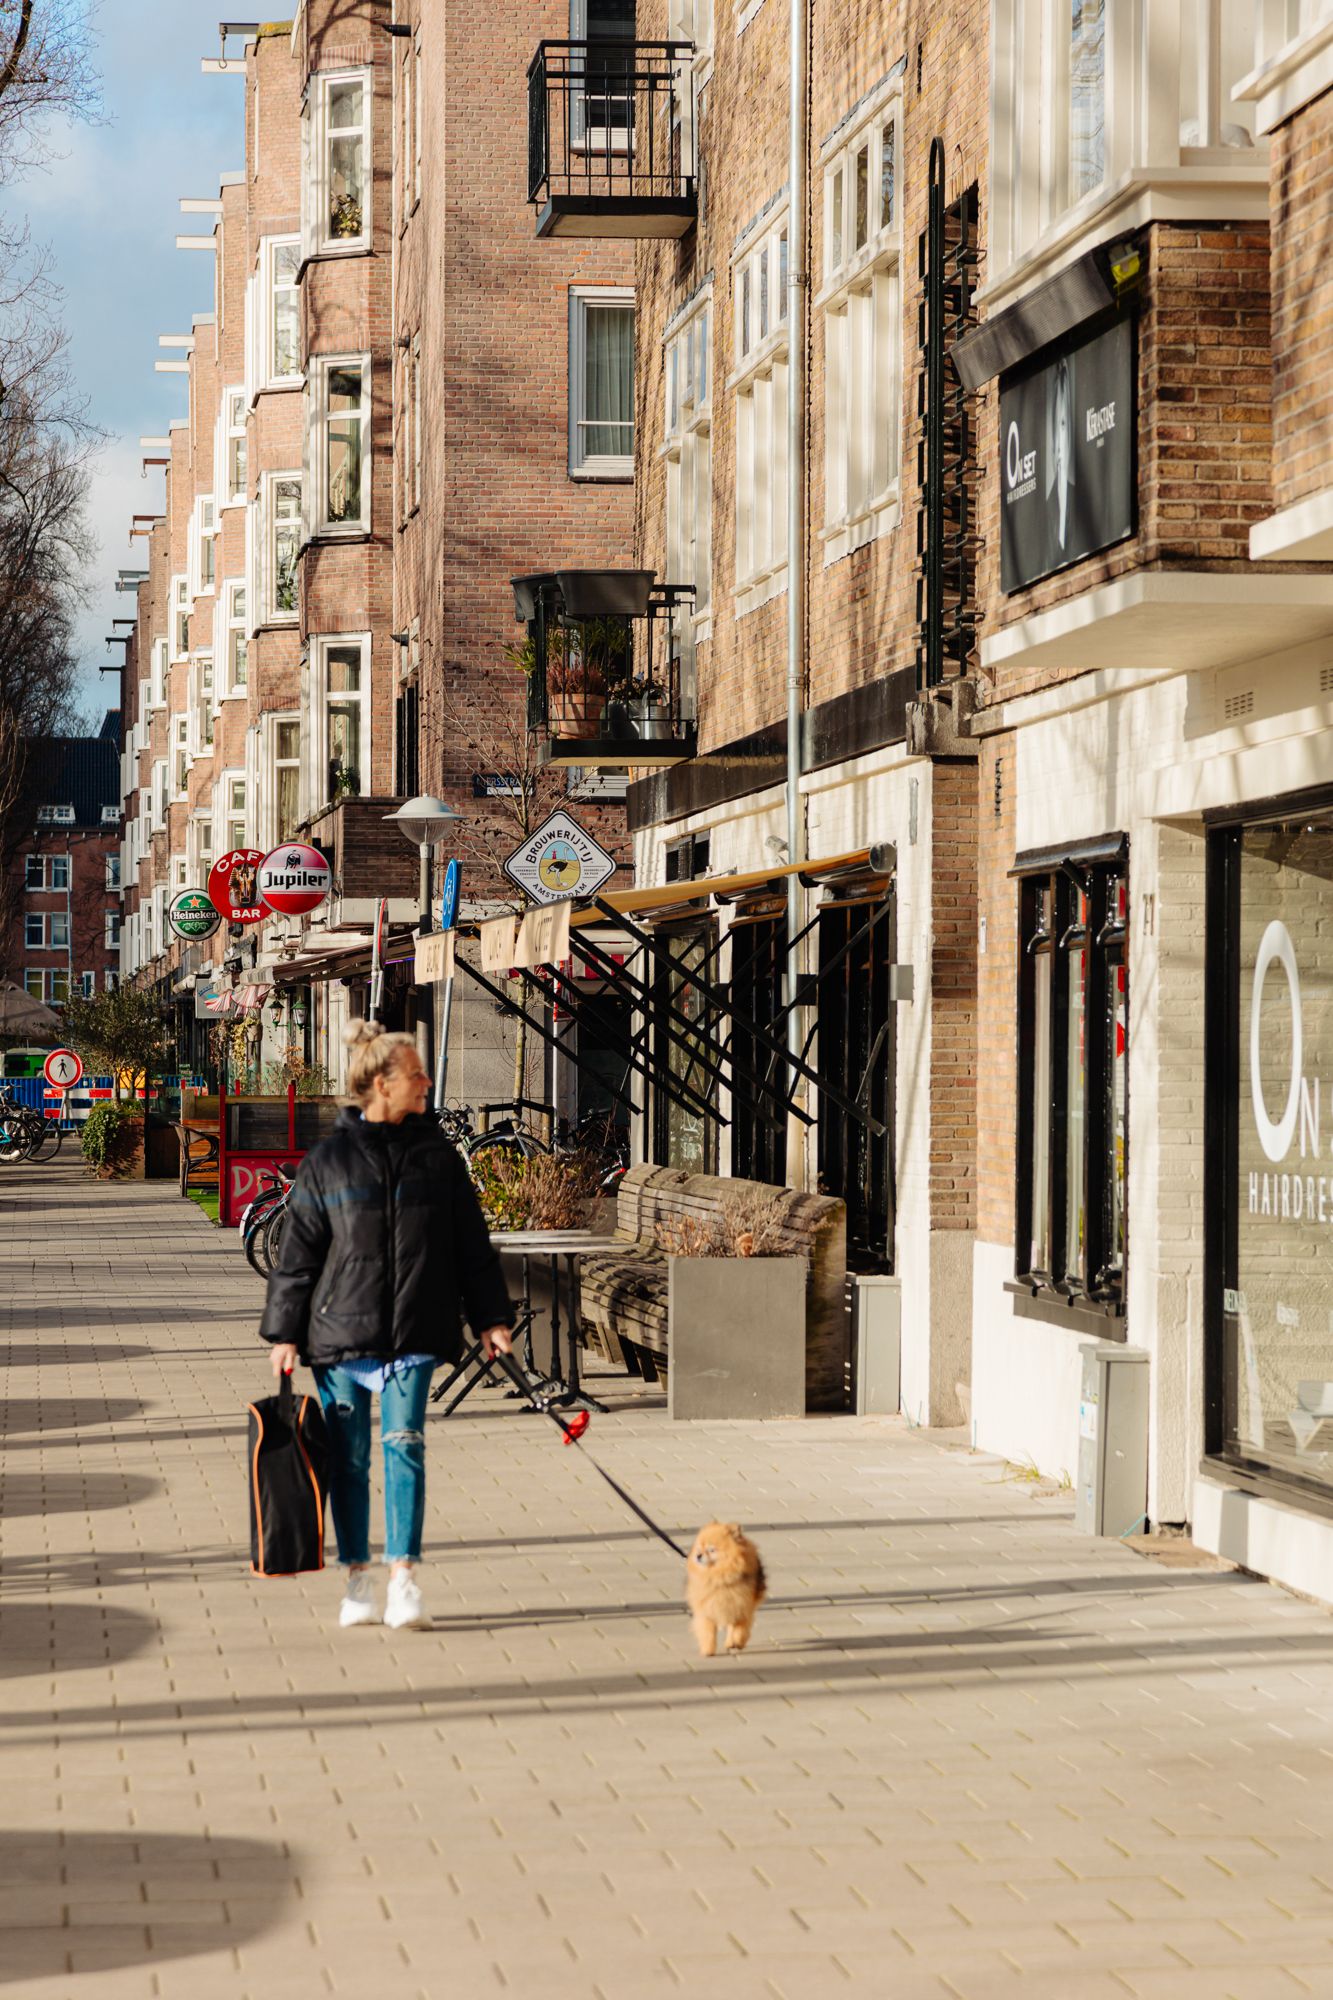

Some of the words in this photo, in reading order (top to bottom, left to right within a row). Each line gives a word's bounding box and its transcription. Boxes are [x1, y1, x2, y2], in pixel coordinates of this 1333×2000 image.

[1023, 450, 1036, 479] SET
[216, 851, 261, 873] CAF
[263, 871, 328, 890] Jupiler
[172, 910, 217, 920] Heineken
[232, 909, 260, 919] BAR
